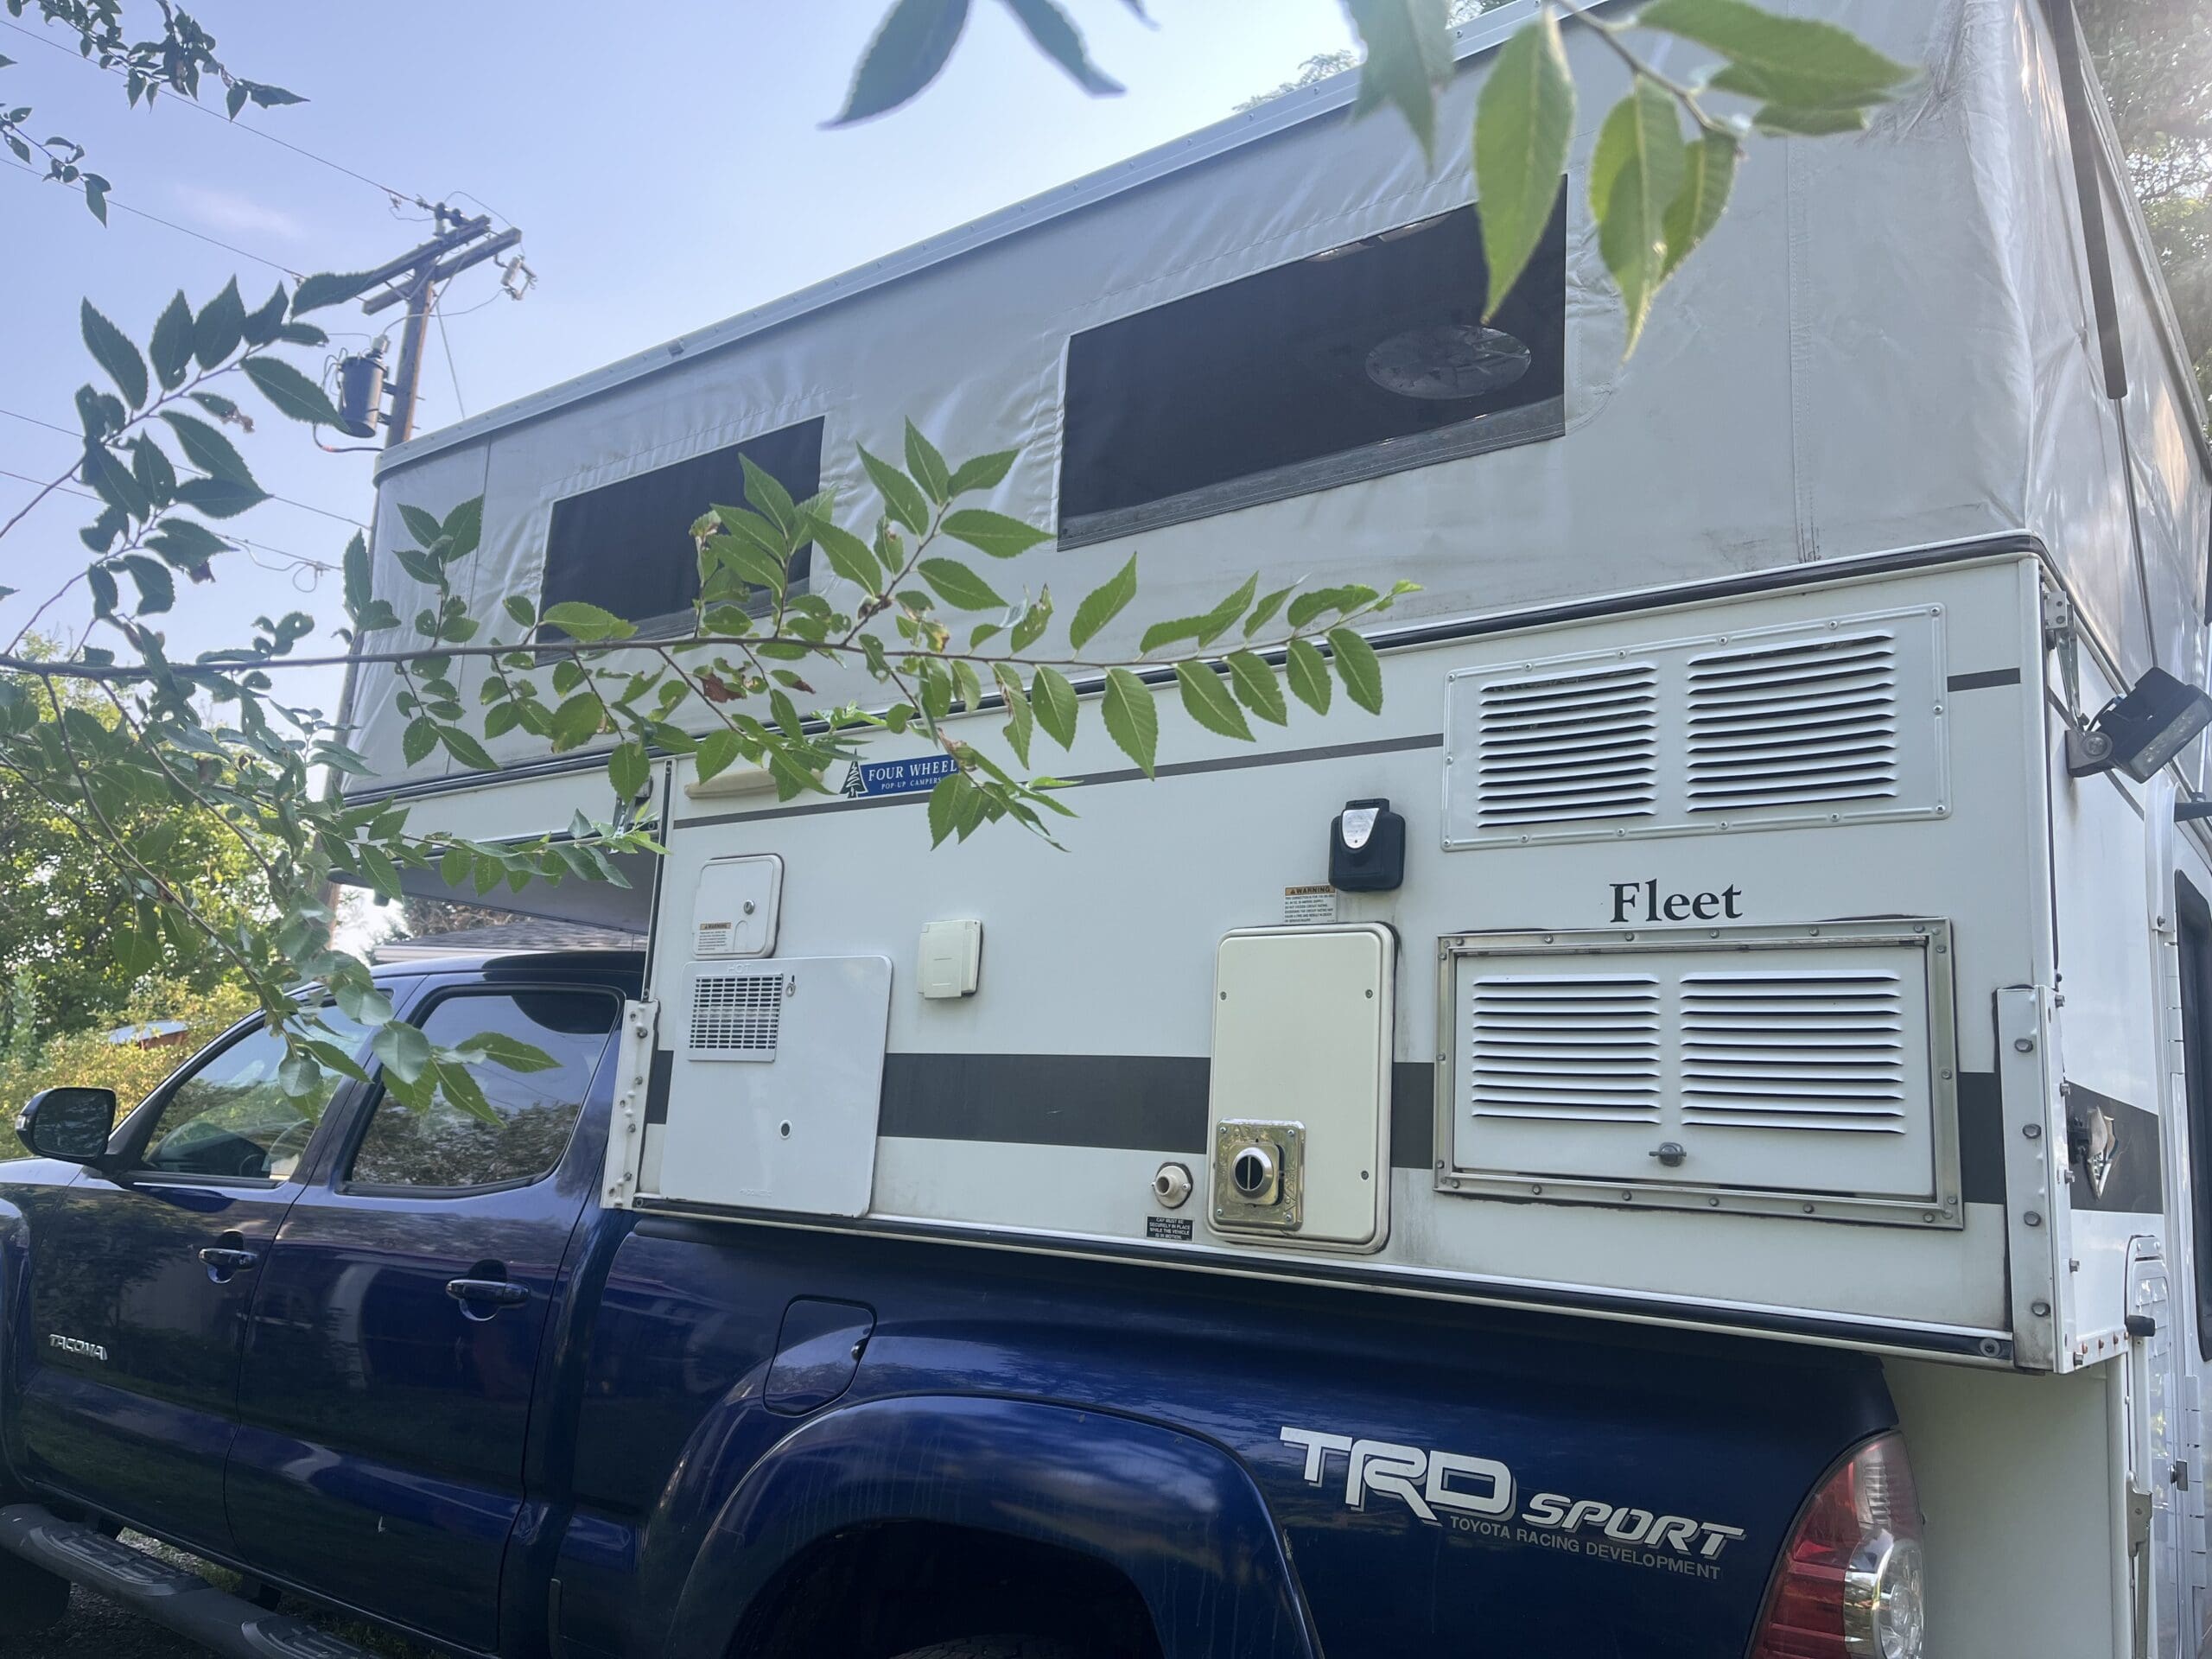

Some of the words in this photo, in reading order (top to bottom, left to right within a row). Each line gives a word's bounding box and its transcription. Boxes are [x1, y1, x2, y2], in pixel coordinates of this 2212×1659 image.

[868, 766, 904, 782] FOUR
[909, 760, 957, 777] WHEEL
[910, 777, 941, 787] CAMPERS
[1609, 878, 1743, 923] Fleet
[48, 1333, 108, 1361] TACOMA
[1280, 1426, 1515, 1525] TRD
[1522, 1492, 1746, 1559] SPORT
[1450, 1516, 1510, 1540] TOYOTA
[1516, 1527, 1580, 1553] RACING
[1586, 1541, 1721, 1580] DEVELOPMENT
